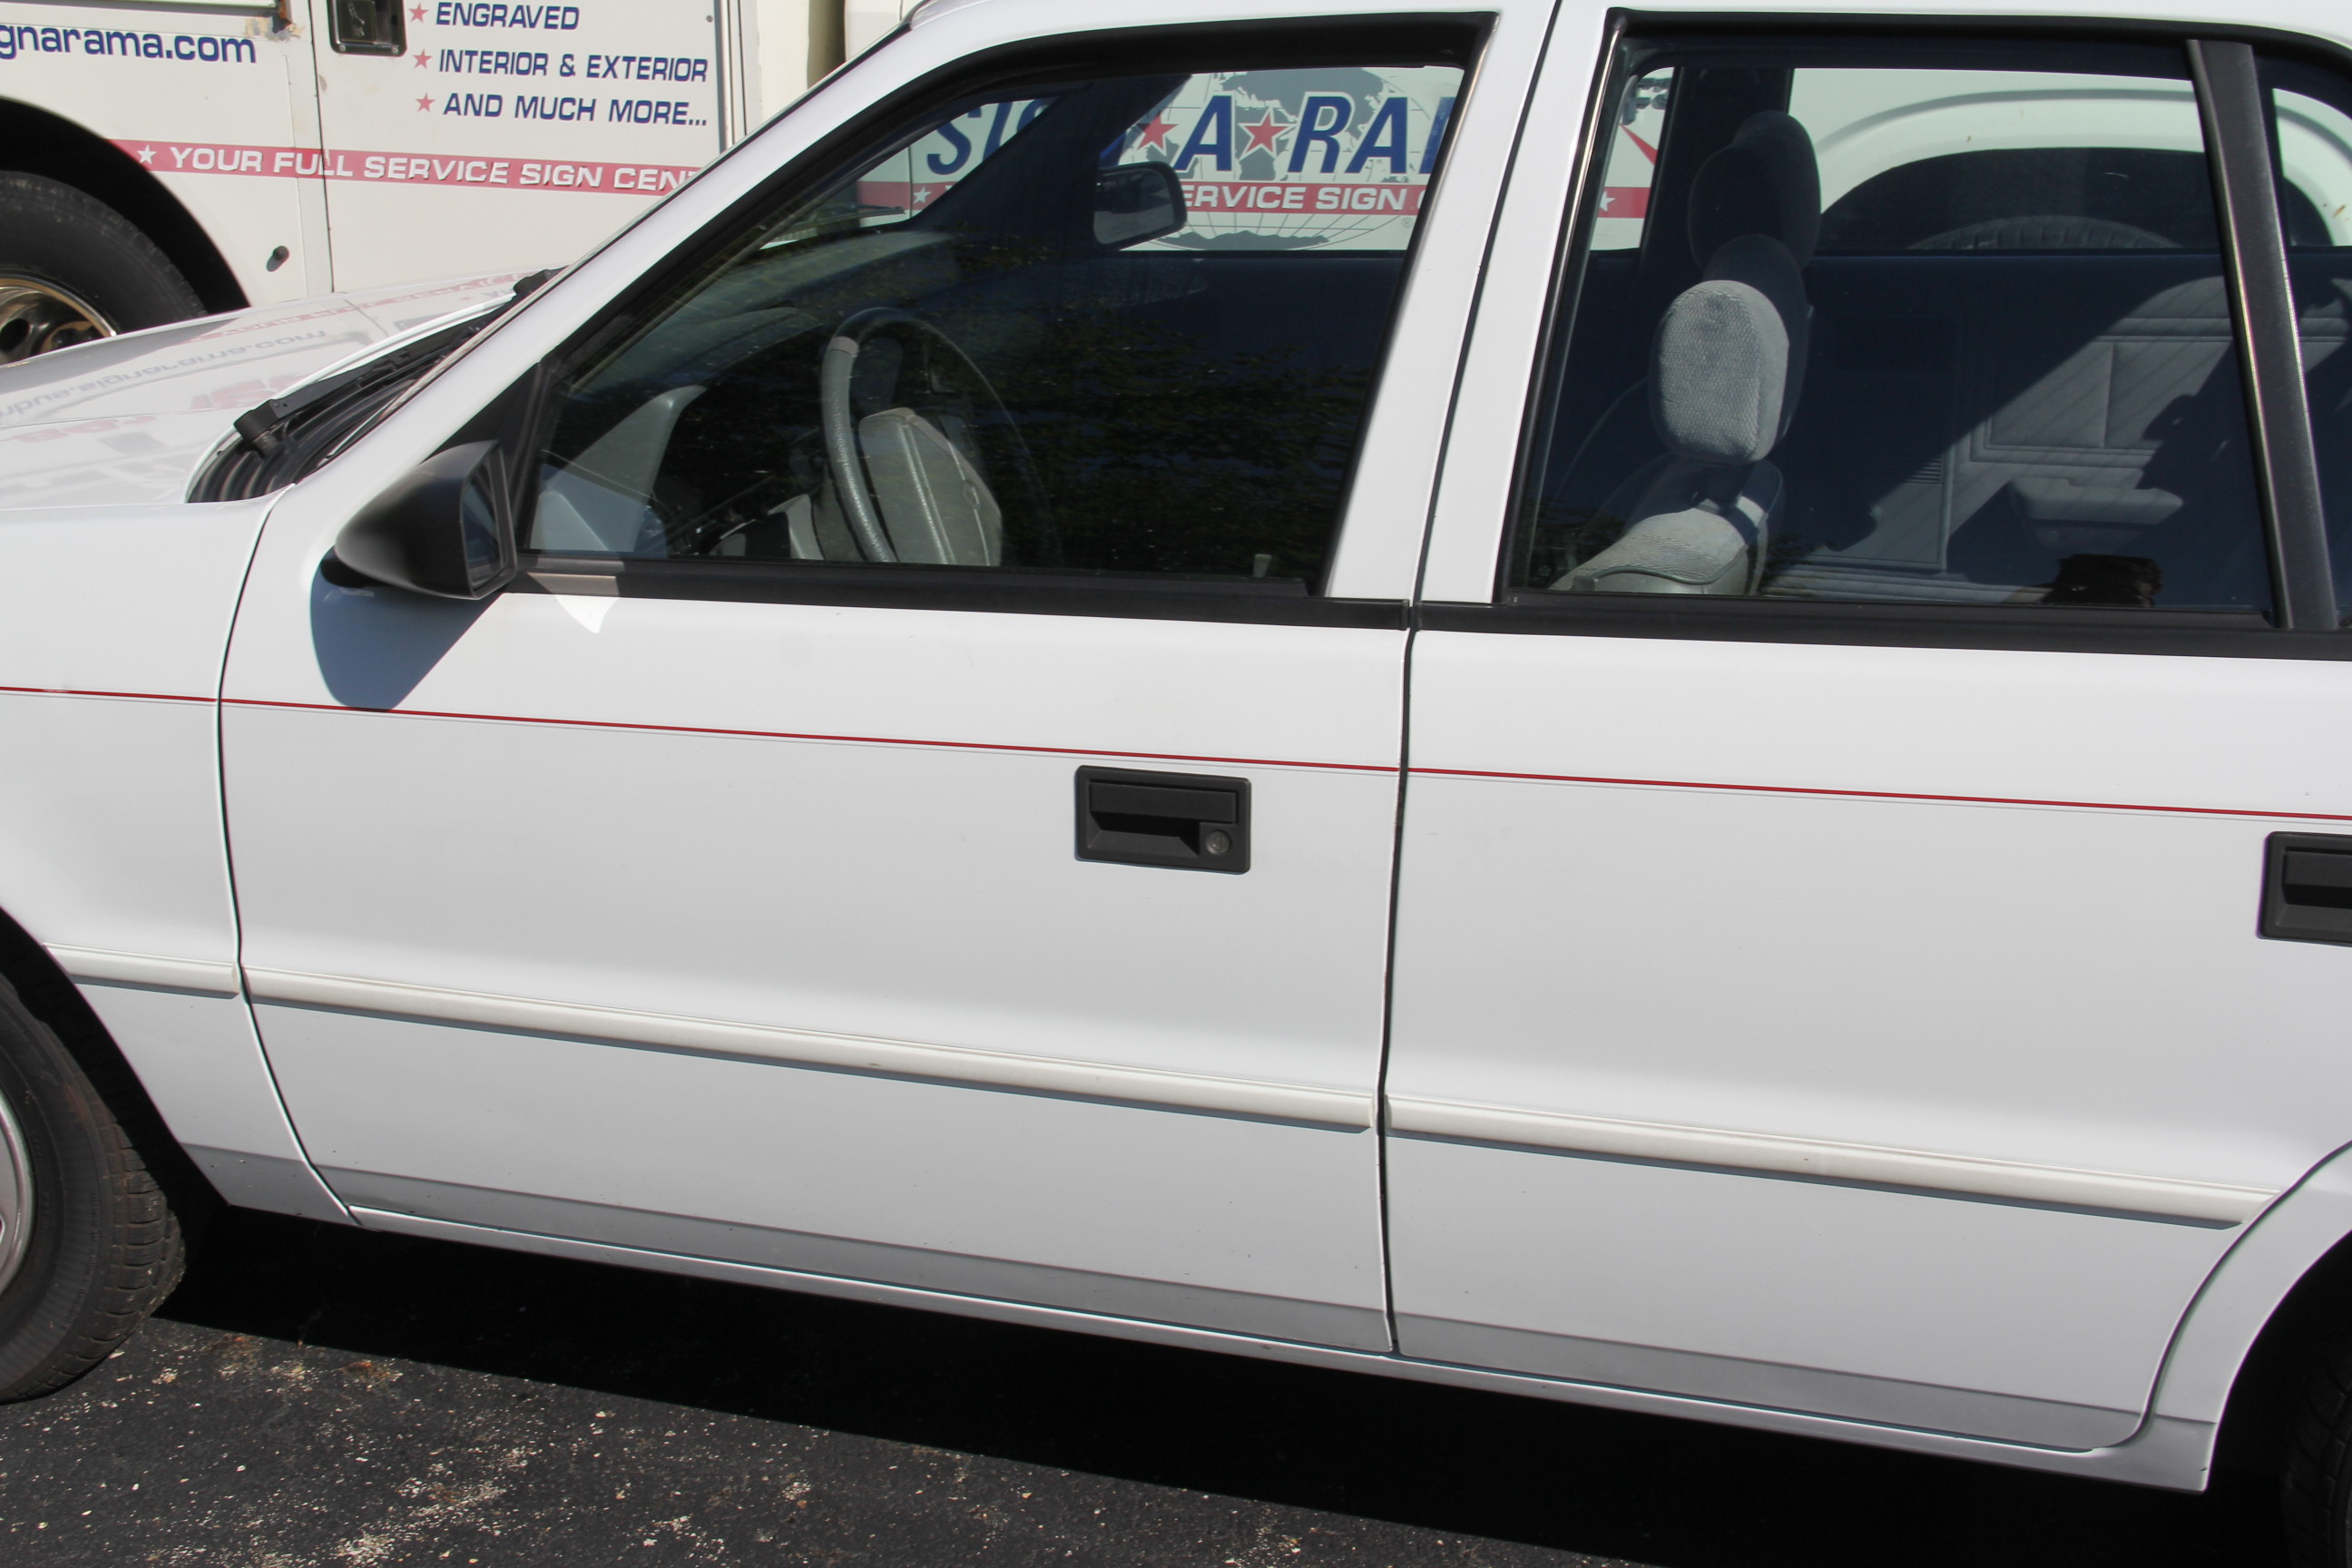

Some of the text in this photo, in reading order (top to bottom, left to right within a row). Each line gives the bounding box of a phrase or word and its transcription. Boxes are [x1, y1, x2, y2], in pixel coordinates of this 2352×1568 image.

[436, 2, 580, 30] ENGRAVED
[439, 49, 709, 83] INTERIOR & EXTERIOR
[443, 93, 707, 126] AND MUCH MORE...
[170, 147, 697, 191] YOUR FULL SERVICE SIGN CEN
[1182, 184, 1307, 210] ERVICE
[1315, 186, 1406, 211] SIGN
